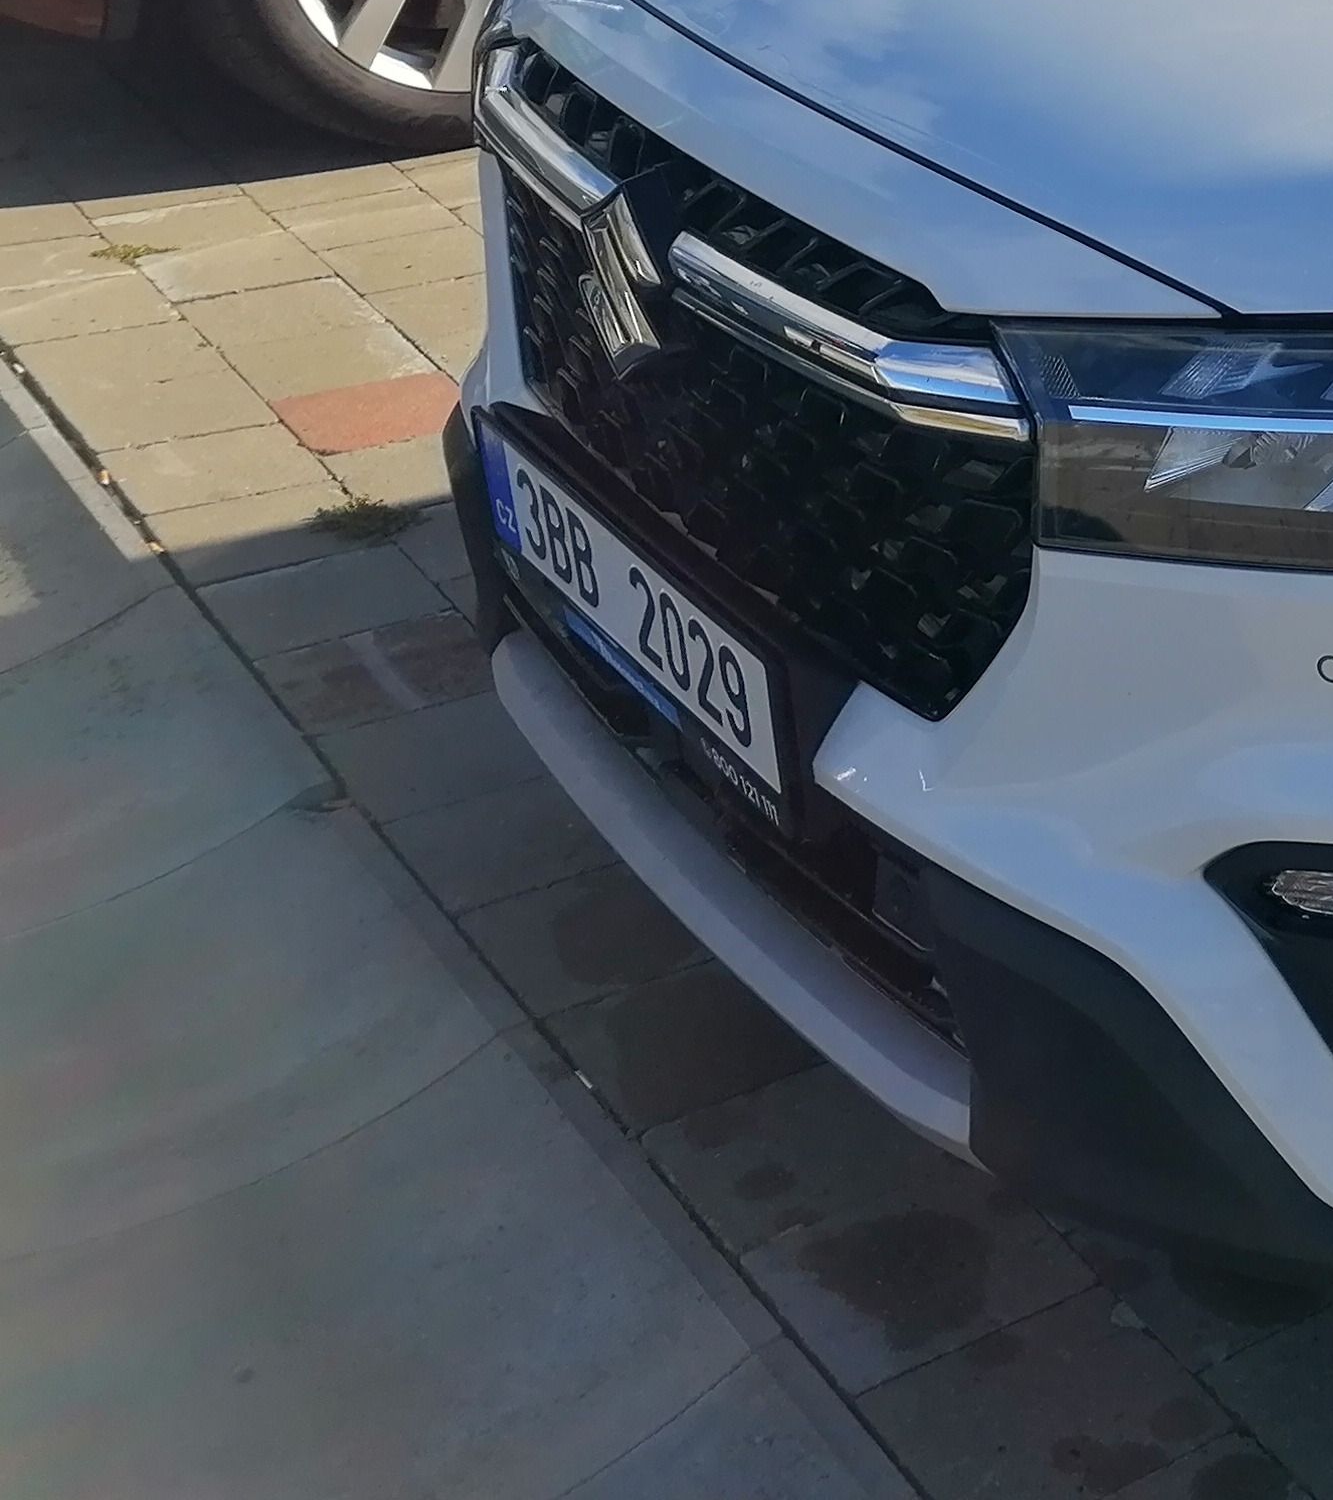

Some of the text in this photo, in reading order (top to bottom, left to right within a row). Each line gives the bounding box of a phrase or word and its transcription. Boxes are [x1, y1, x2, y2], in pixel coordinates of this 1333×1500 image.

[495, 497, 517, 534] CZ
[515, 463, 600, 610] 3BB
[628, 567, 753, 750] 2029
